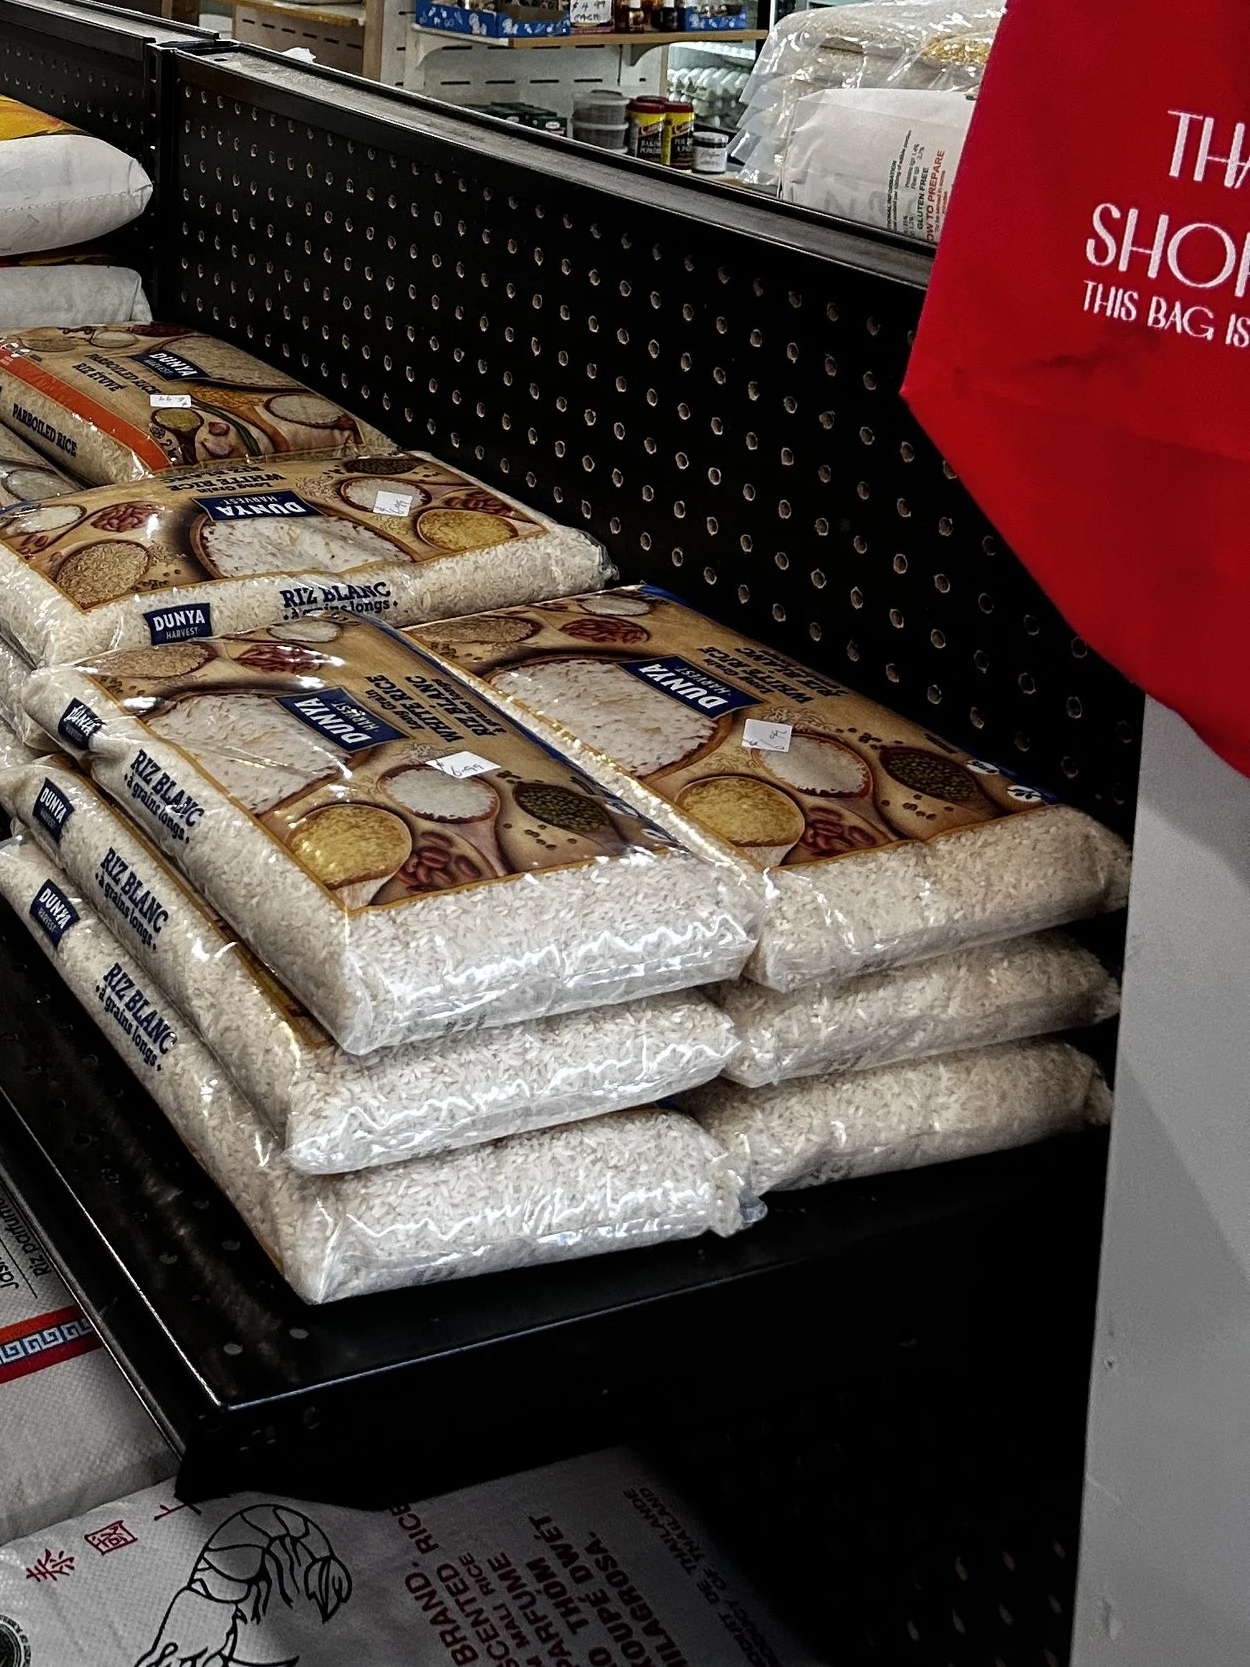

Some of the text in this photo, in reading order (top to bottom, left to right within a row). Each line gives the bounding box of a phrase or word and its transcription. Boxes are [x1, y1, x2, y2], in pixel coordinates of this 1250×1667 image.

[917, 167, 929, 230] GLUTEN FREE
[928, 150, 945, 204] PREPARE
[926, 205, 934, 220] TO
[1083, 279, 1250, 348] THIS BAG IS
[150, 351, 199, 378] DUNYA
[12, 403, 78, 458] PARBOILED RICE
[215, 501, 307, 517] DUNYA
[279, 581, 391, 609] RIZ BLANC
[350, 598, 391, 615] longs
[152, 609, 205, 632] DUNYA
[165, 626, 199, 640] HARVEST
[364, 689, 397, 711] Grain
[638, 663, 729, 710] DUNYA
[677, 665, 730, 696] HARVEST
[294, 697, 373, 744] DUNYA
[364, 674, 465, 743] WHITE RICE
[405, 675, 498, 737] RIZ BLANC
[39, 787, 68, 824] DUNYA
[130, 748, 205, 828] RIZ BLANC
[131, 783, 185, 841] grains longs
[39, 888, 72, 929] DUNYA
[100, 846, 169, 934] RIZ BLANC
[104, 883, 153, 948] grains longs
[103, 962, 178, 1055] RIZ BLANC
[104, 997, 159, 1067] grains longs
[29, 1257, 54, 1278] Riz
[638, 1486, 706, 1564] THAILAND
[459, 1551, 531, 1649] MALI RICE
